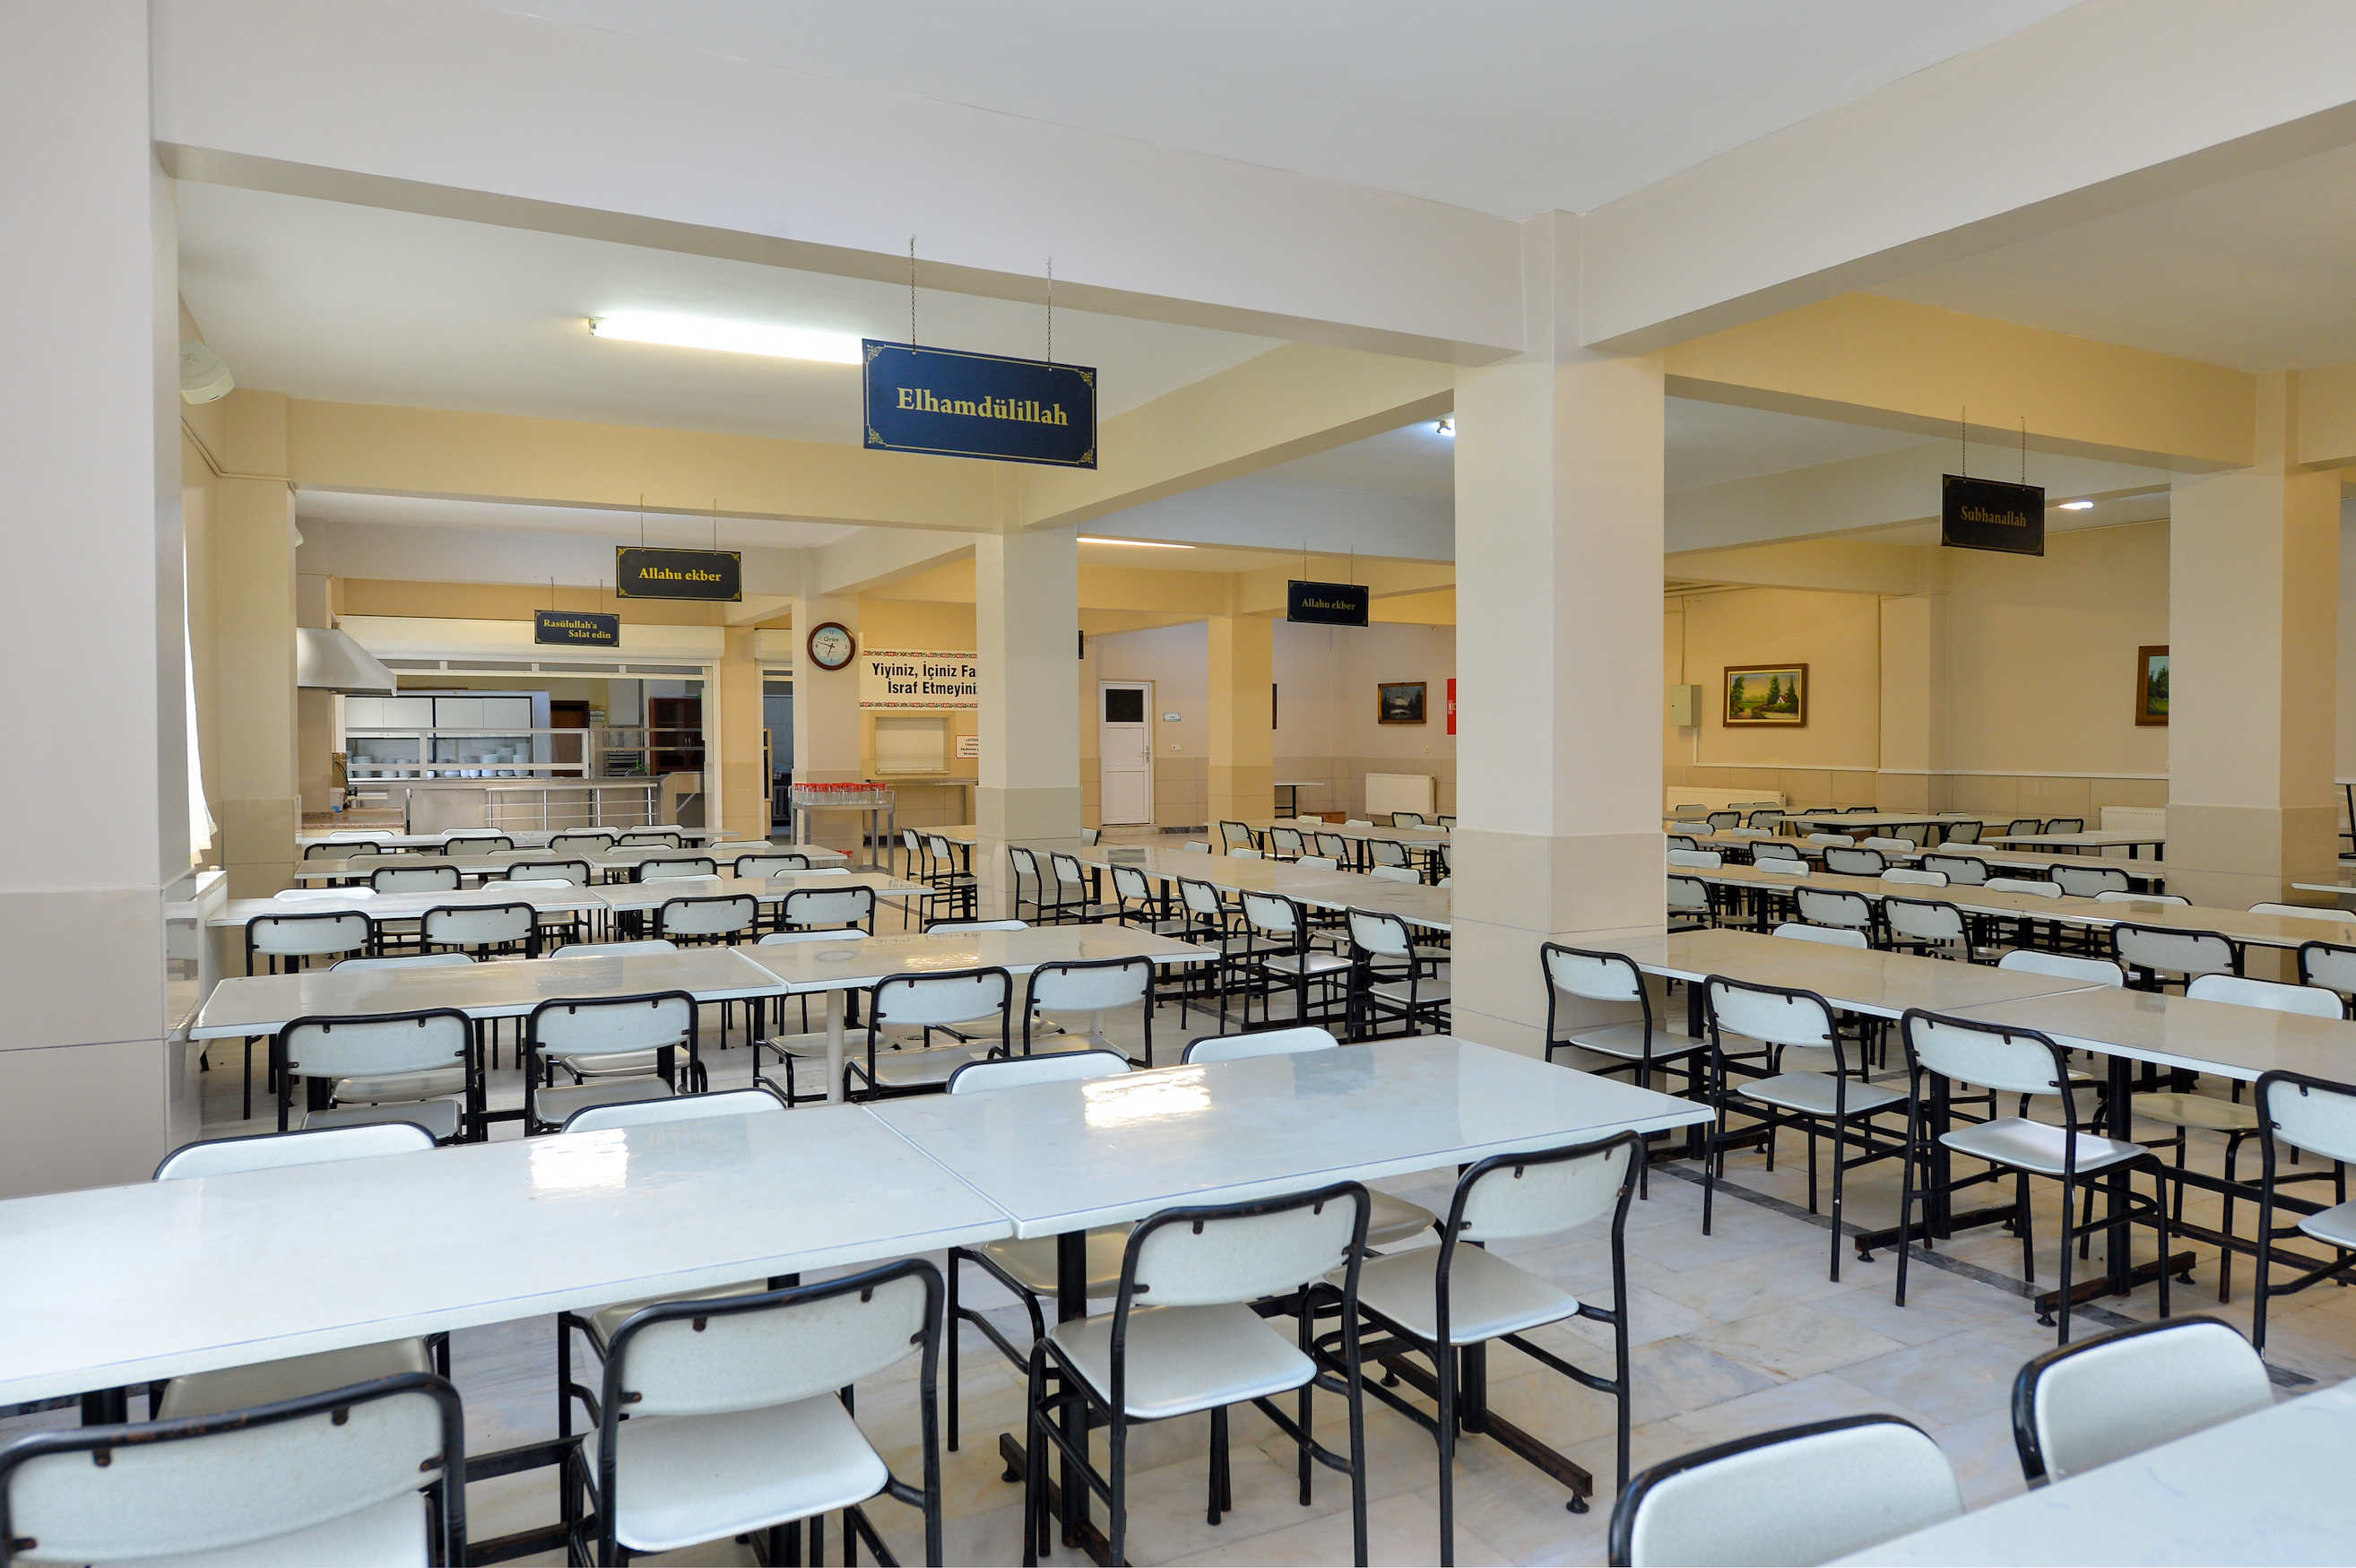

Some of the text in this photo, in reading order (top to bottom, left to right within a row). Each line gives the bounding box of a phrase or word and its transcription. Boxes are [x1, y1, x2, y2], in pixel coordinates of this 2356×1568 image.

[896, 386, 1068, 426] Elhamdülillah
[1961, 505, 2026, 527] Subhanallah
[638, 567, 722, 582] Allahu ekber
[1302, 598, 1356, 611] Allahu ekber
[543, 619, 597, 629] Rasülullah'a
[568, 629, 611, 639] Salat edin
[872, 663, 918, 679] Yiyiniz,
[922, 661, 957, 680] İçiniz
[888, 678, 978, 697] İsraf Etmeyini
